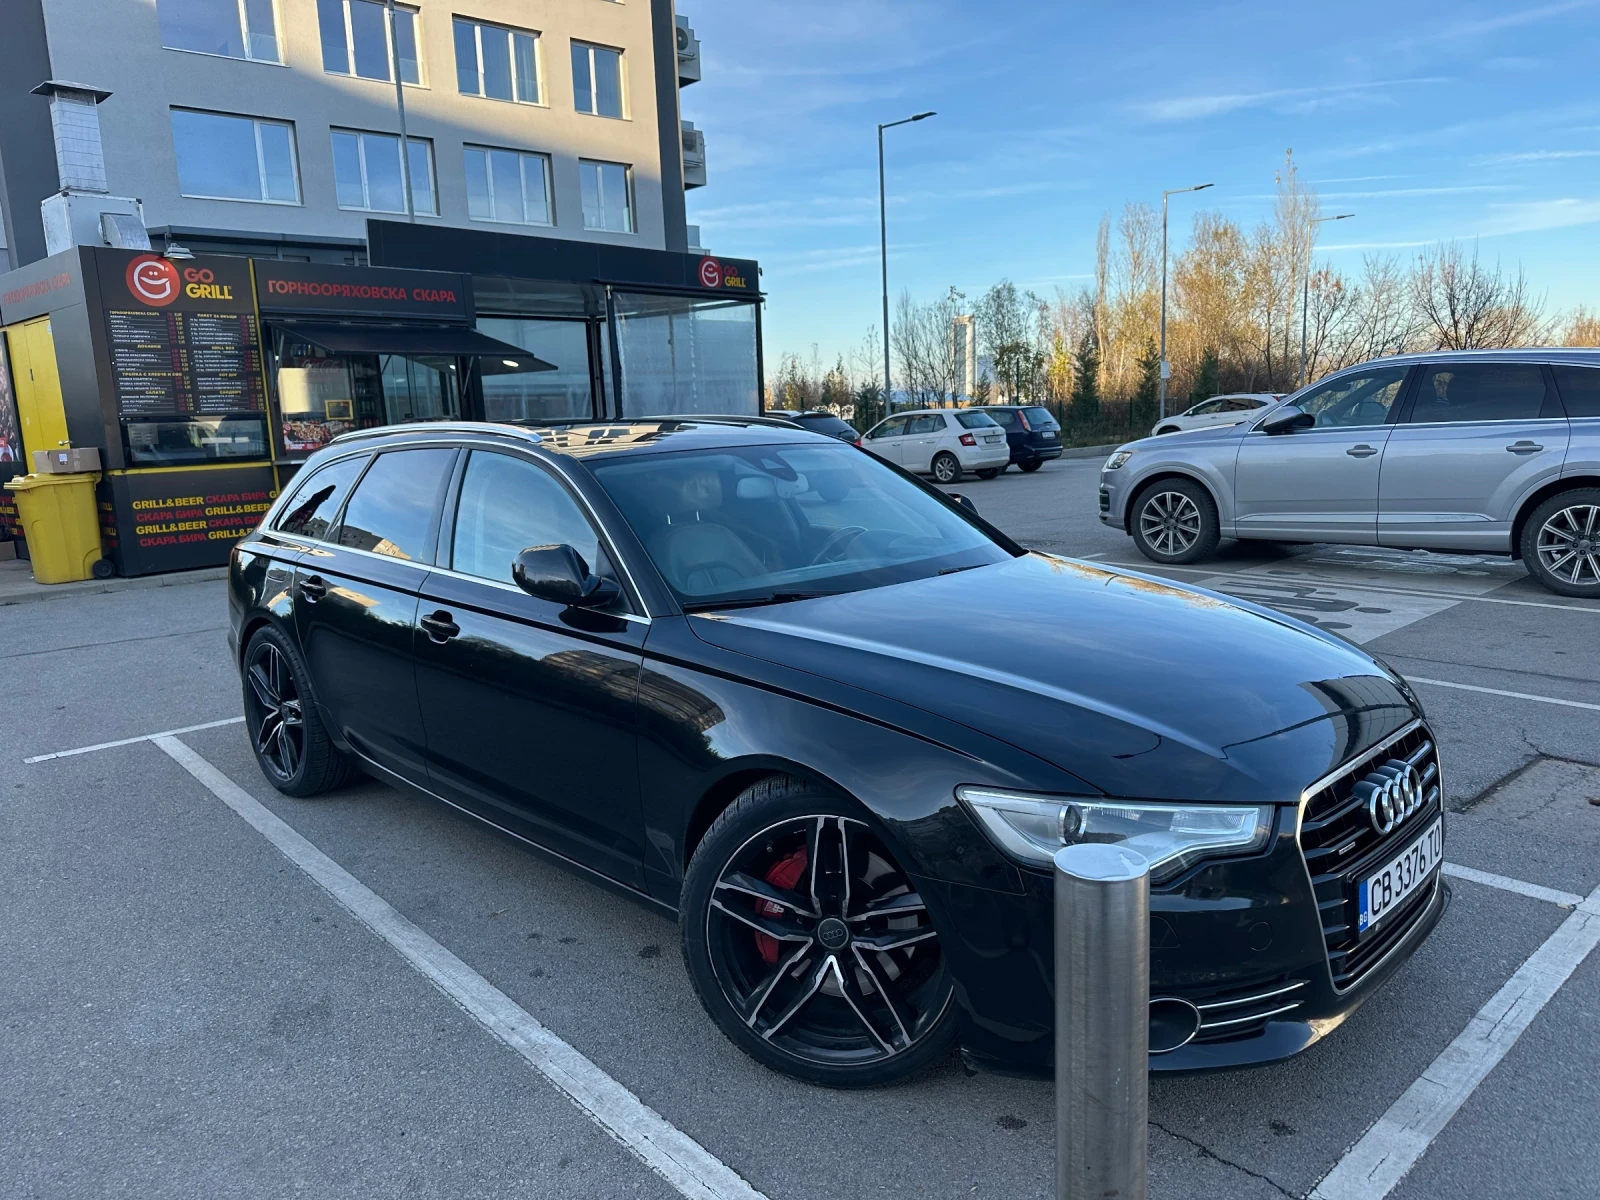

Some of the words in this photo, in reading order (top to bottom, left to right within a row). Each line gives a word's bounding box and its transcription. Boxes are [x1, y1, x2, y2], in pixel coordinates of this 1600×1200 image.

[183, 267, 215, 284] GO
[724, 275, 747, 288] GRILL
[185, 283, 233, 300] GRILL
[268, 279, 407, 300] ГОРНООРЯХОВСКА
[412, 288, 457, 303] СКАРА
[132, 496, 204, 510] GRILL&BEER
[205, 493, 240, 504] СКАРА
[241, 491, 268, 501] БИРА
[136, 511, 174, 522] СКАРА
[175, 509, 204, 519] БИРА
[135, 520, 208, 535] GRILL&BEER
[208, 517, 243, 528] СКАРА
[139, 535, 178, 547] СКАРА
[178, 532, 207, 543] БИРА
[1395, 839, 1426, 898] 3376
[1359, 911, 1368, 926] BG
